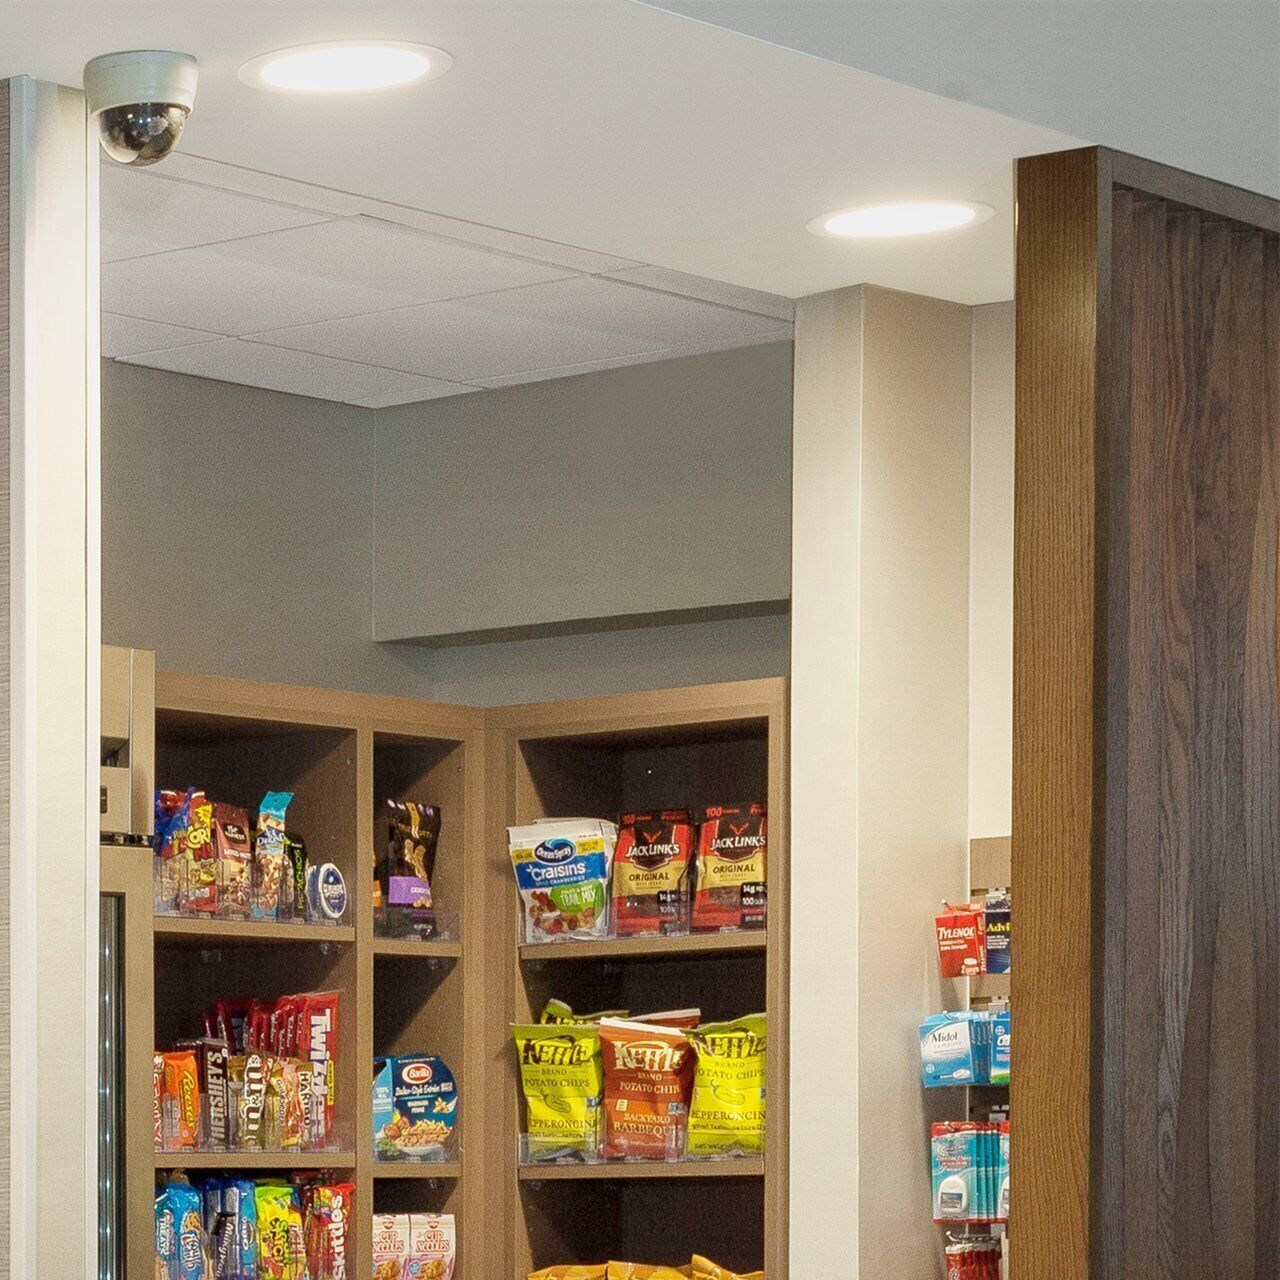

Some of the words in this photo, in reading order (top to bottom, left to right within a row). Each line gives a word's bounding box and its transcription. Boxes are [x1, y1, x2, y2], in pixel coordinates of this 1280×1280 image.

[711, 836, 734, 851] JACK
[734, 835, 767, 848] LINK'S
[536, 847, 554, 859] Ocean
[554, 846, 572, 860] Spray
[625, 844, 649, 858] JACK
[649, 843, 681, 856] LINK'S
[531, 862, 587, 882] Craisins
[712, 863, 756, 874] ORIGINAL
[628, 871, 671, 882] ORIGINAL
[560, 893, 580, 907] TRAIL
[581, 887, 597, 903] MIX
[937, 926, 975, 940] TYLENOL
[986, 922, 1011, 932] Advi
[931, 1031, 958, 1043] Midol
[522, 1036, 593, 1066] KETTLE
[541, 1068, 568, 1076] BRAND
[637, 1072, 662, 1081] BRAND
[736, 1068, 766, 1081] CHIPS
[524, 1079, 558, 1088] POTATO
[559, 1078, 590, 1088] CHIPS
[619, 1081, 653, 1093] POTATO
[207, 1051, 226, 1139] HERSHEY'S
[297, 1070, 312, 1127] HARIBO
[623, 1112, 671, 1124] BACKYARD
[691, 1109, 766, 1121] PEPPERONCIN
[379, 1231, 399, 1241] CUP
[424, 1230, 444, 1241] CUP
[372, 1240, 405, 1254] NOODLES
[416, 1240, 450, 1253] NOODLES
